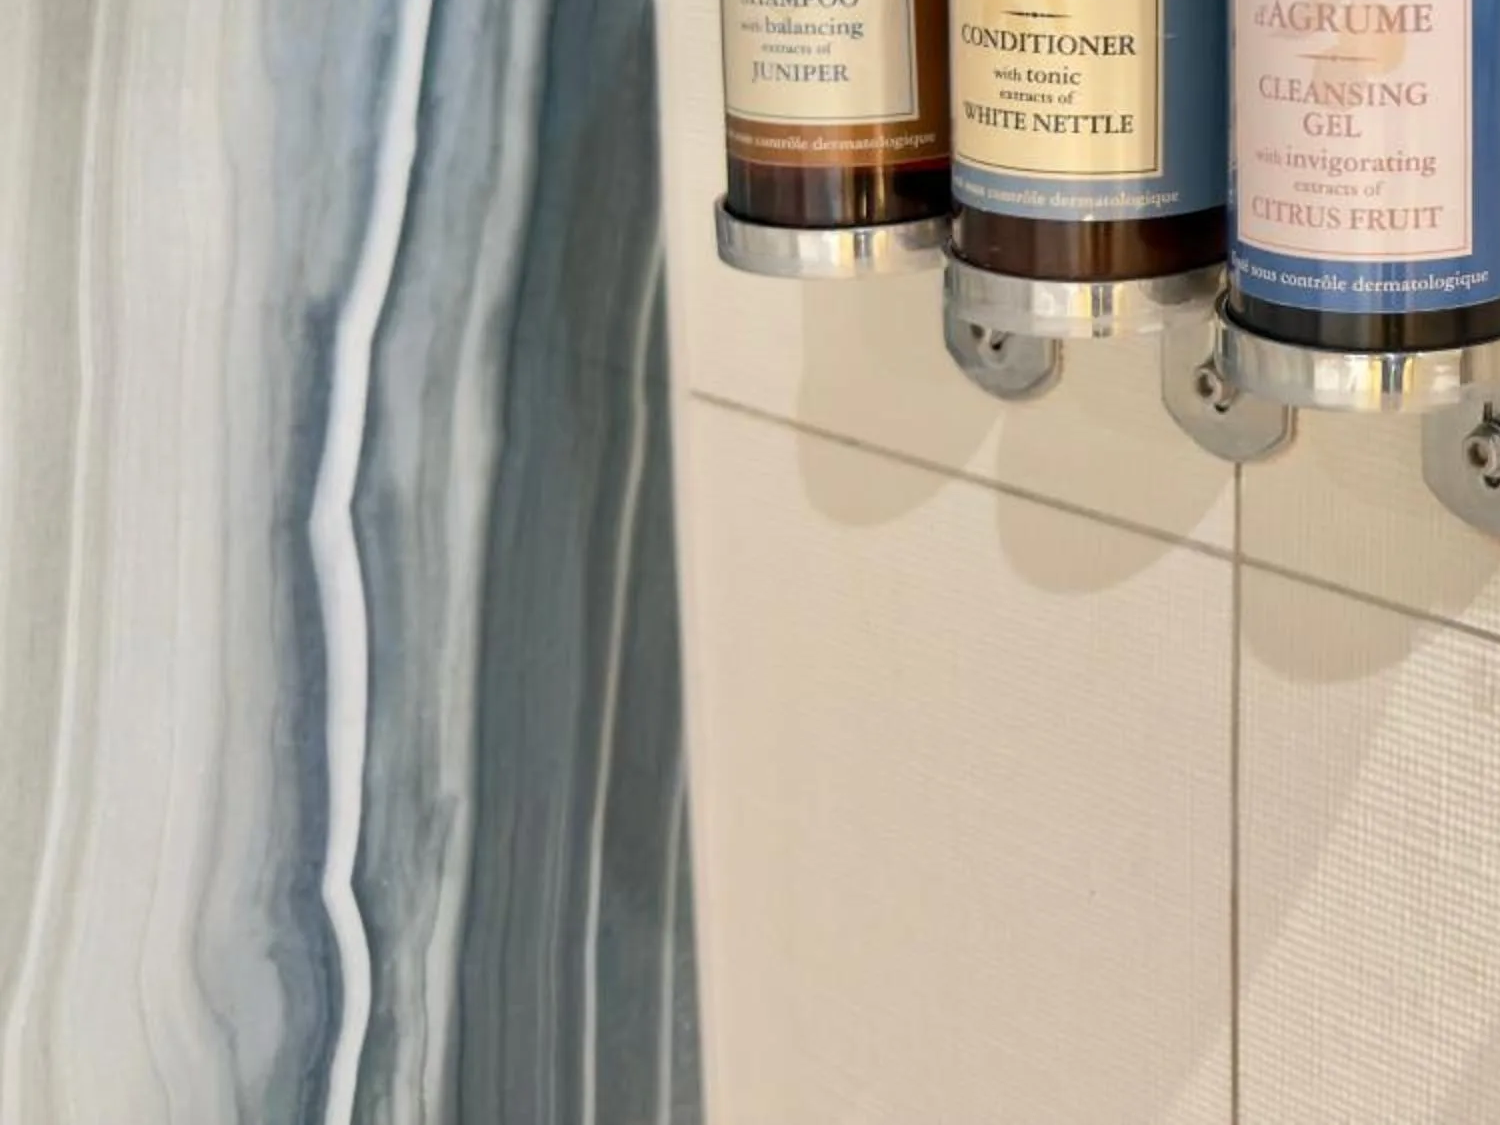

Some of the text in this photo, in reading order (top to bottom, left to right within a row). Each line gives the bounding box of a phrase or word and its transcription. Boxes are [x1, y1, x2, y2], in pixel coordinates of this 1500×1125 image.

[765, 16, 864, 39] balancing
[961, 23, 1137, 56] CONDITIONER
[751, 61, 849, 83] JUNIPER
[994, 66, 1081, 86] with tonic
[1000, 89, 1075, 105] extracts of
[1259, 75, 1428, 106] CLEANSING
[963, 101, 1134, 134] WHITE NETTLE
[1303, 112, 1361, 138] GEL
[1256, 144, 1437, 177] with invigorating
[1293, 179, 1384, 197] extracts of
[1251, 196, 1443, 232] CITRUS FRUIT
[1251, 266, 1489, 294] sous contrôle dermatologique
